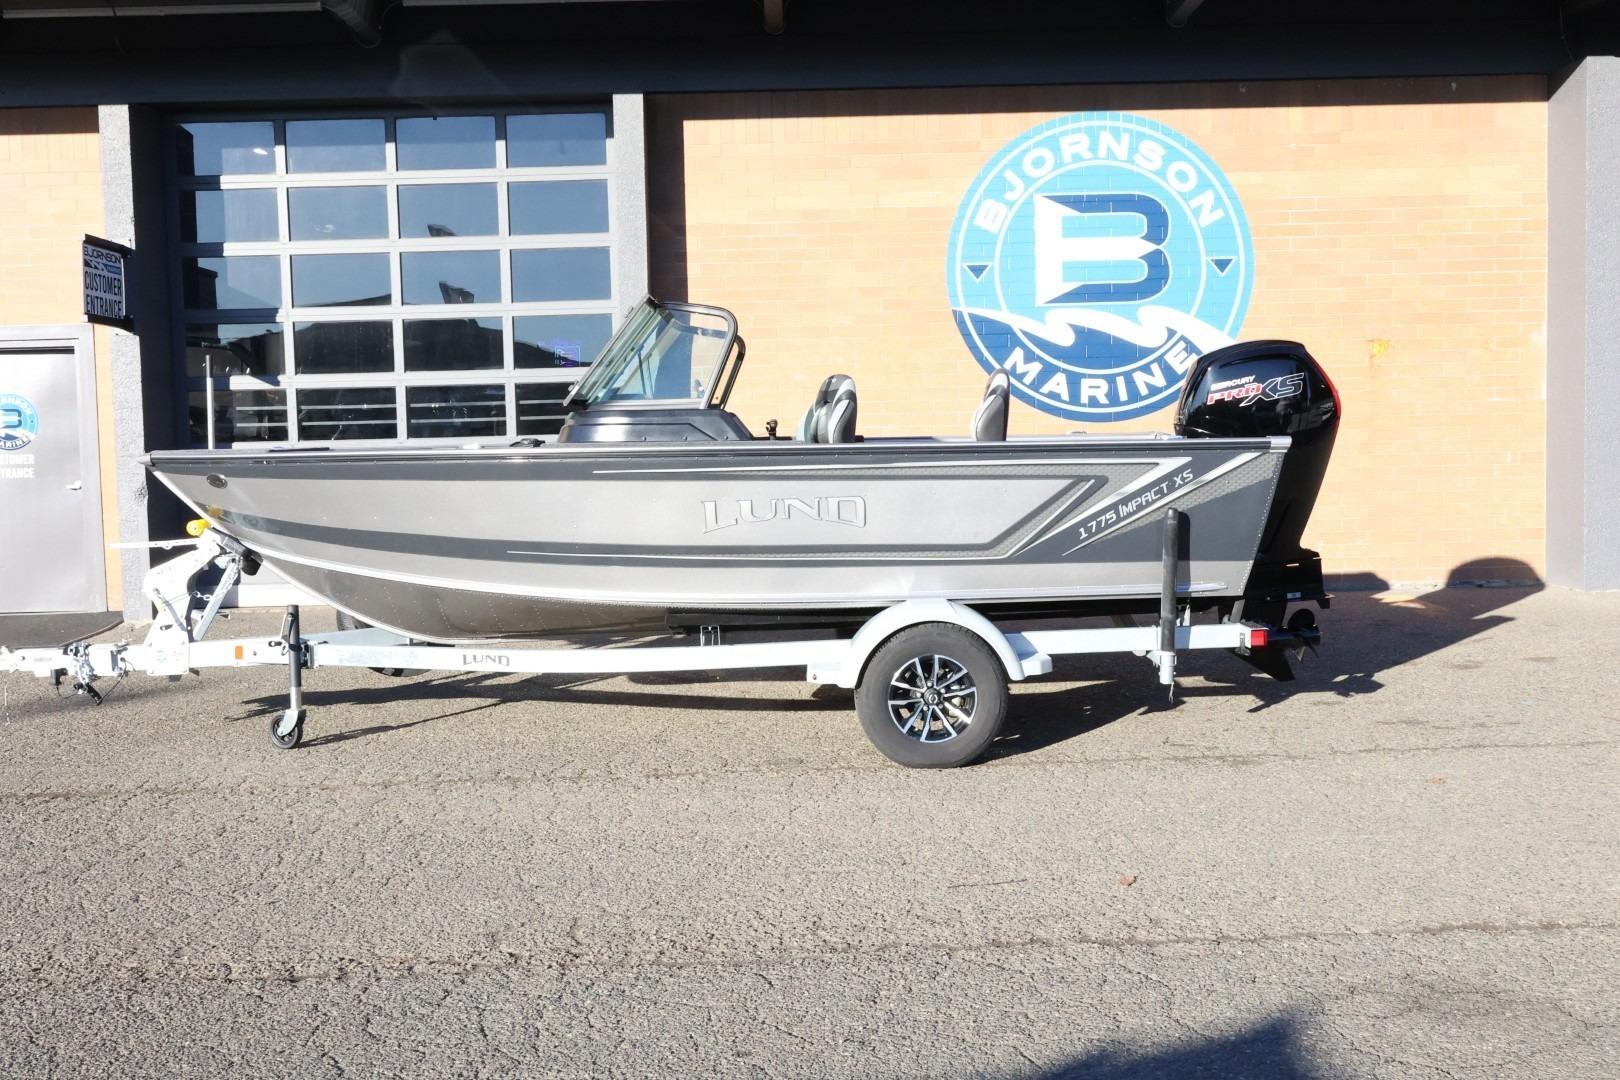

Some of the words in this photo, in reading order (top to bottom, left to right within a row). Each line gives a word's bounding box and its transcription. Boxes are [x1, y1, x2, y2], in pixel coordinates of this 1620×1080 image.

[973, 130, 1225, 234] BJORNSON
[84, 246, 121, 264] BJORNSON
[85, 271, 122, 296] CUSTOMER
[86, 294, 123, 319] ENTRANCE
[1003, 340, 1199, 405] MARINE
[1211, 375, 1256, 391] MERCURY
[701, 495, 867, 534] LUND
[1078, 510, 1117, 540] 1775
[1118, 481, 1169, 518] IMPACT
[1173, 468, 1194, 488] XS
[462, 654, 510, 667] LUND
